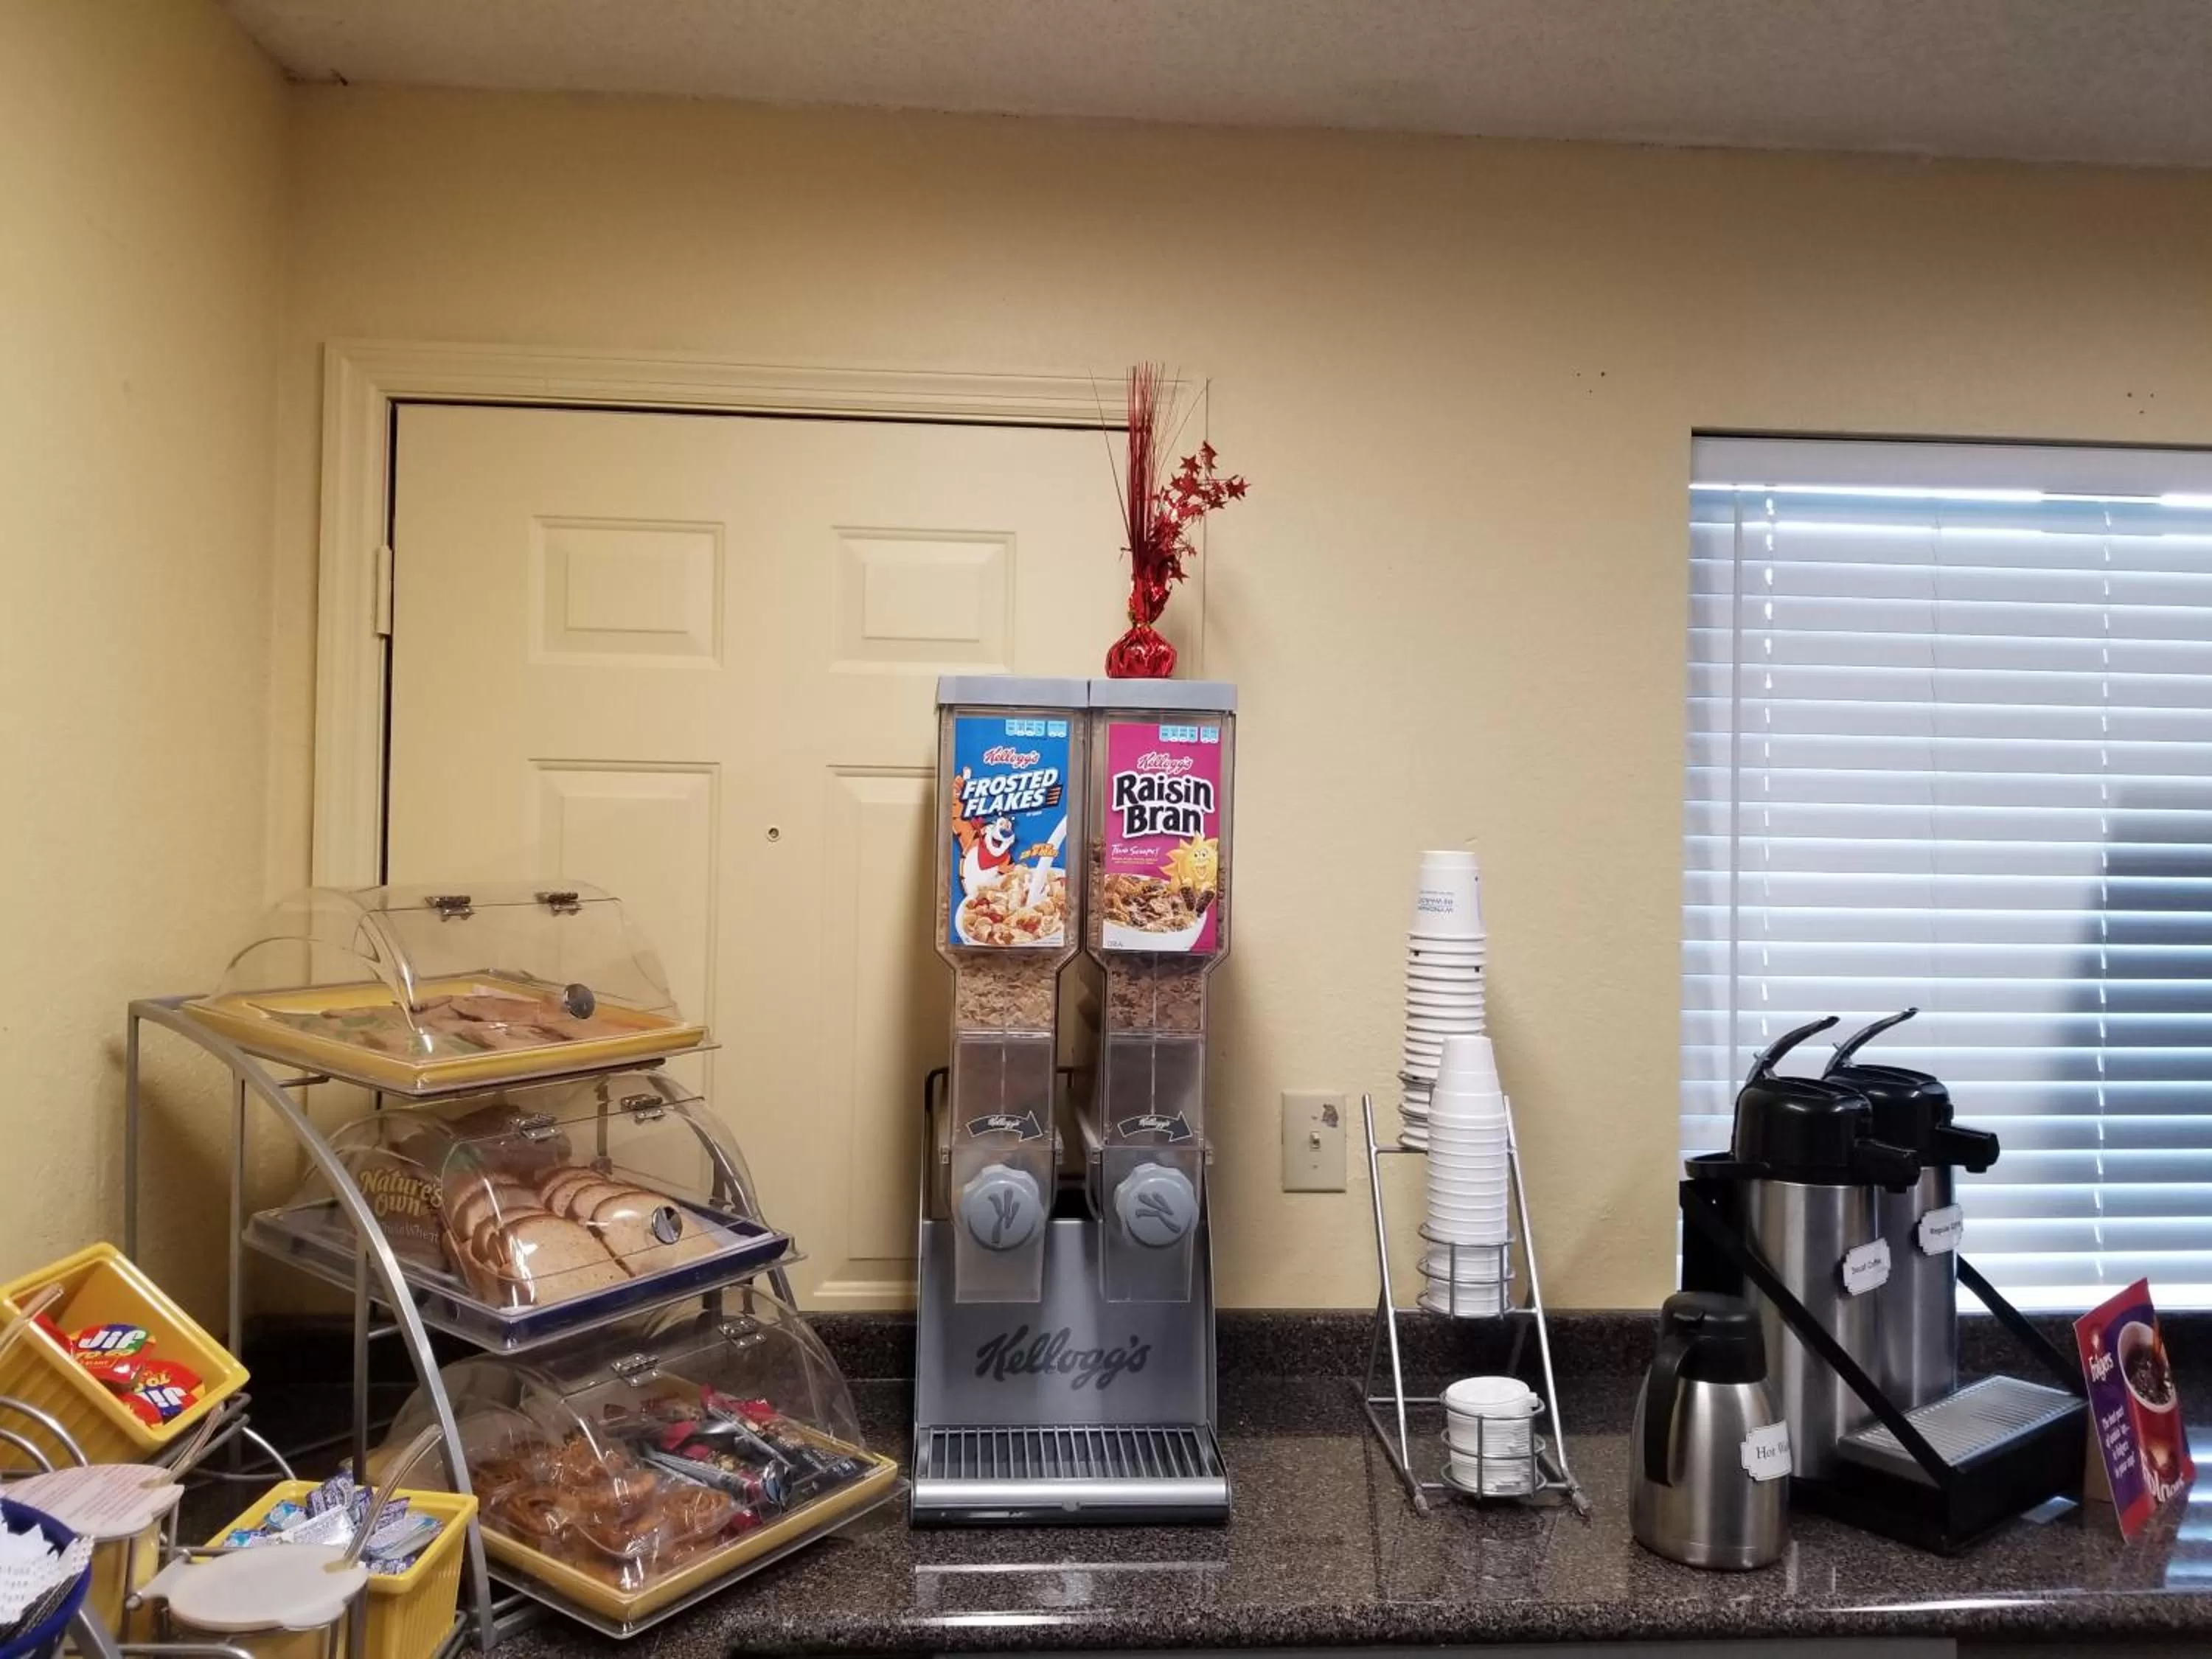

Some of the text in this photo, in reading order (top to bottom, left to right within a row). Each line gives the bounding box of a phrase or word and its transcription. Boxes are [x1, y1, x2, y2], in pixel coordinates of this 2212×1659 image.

[983, 746, 1040, 769] Kellogg's
[1136, 752, 1194, 774] Kellogg's
[962, 768, 1059, 801] FROSTED
[1114, 773, 1214, 810] Raisin
[965, 787, 1046, 817] FLAKES
[1125, 804, 1204, 837] Bran
[358, 1169, 443, 1208] Nature's
[374, 1193, 422, 1219] Own
[78, 1329, 147, 1349] Jif
[975, 1324, 1152, 1391] Kellogg's
